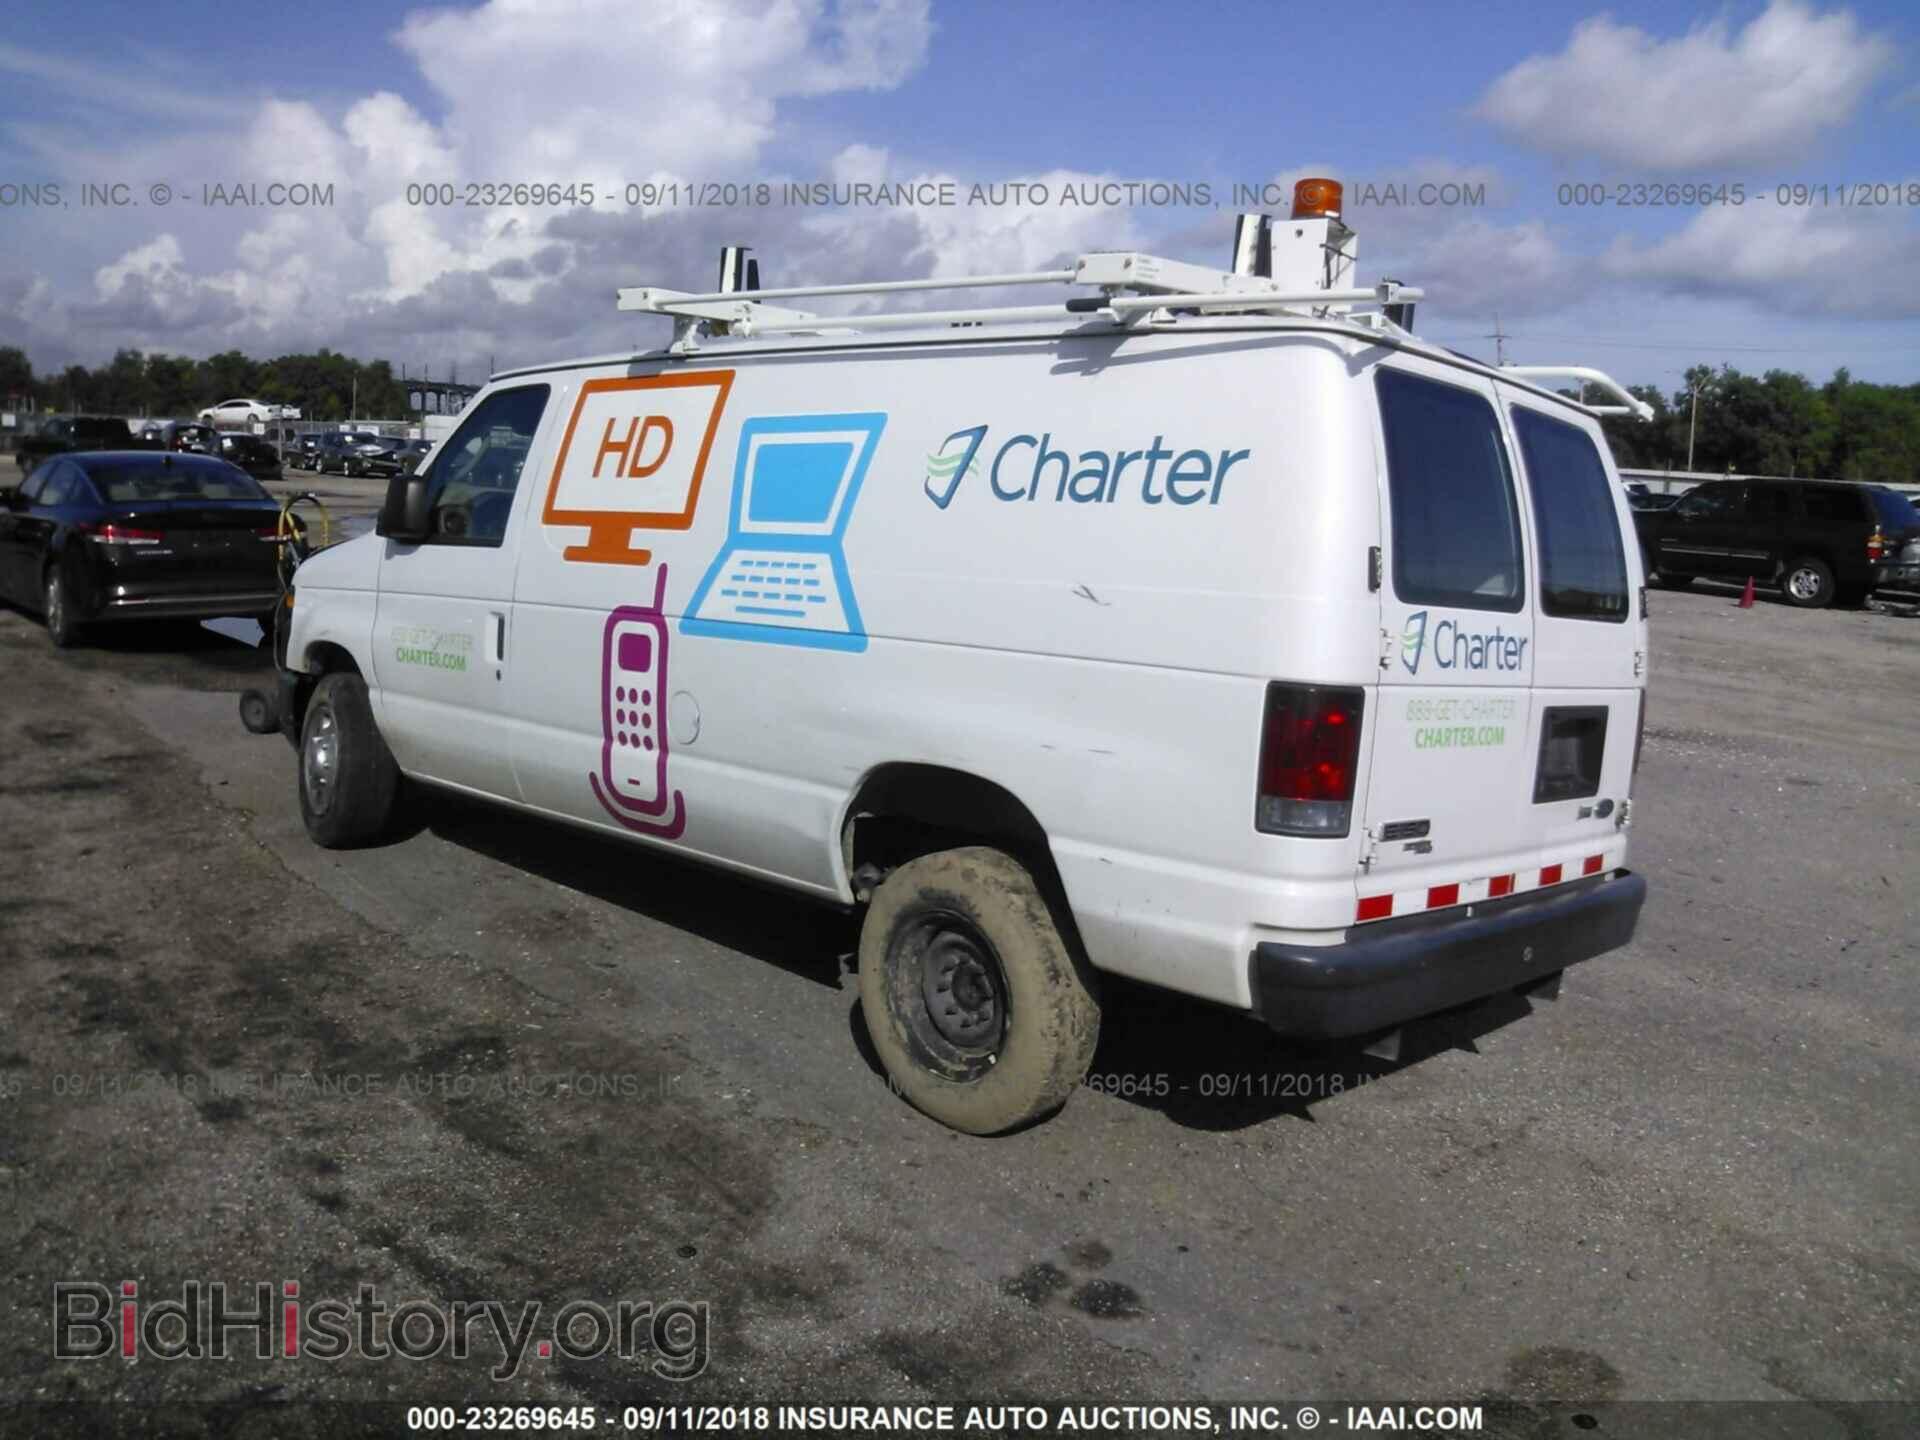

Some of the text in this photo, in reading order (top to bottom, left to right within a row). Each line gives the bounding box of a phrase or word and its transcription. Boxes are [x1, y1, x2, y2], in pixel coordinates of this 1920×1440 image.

[592, 415, 674, 478] HD
[990, 432, 1251, 506] Charter
[396, 647, 467, 672] CHARTER.COM
[1434, 619, 1528, 671] Charter
[1415, 726, 1505, 749] CHARTER.COM
